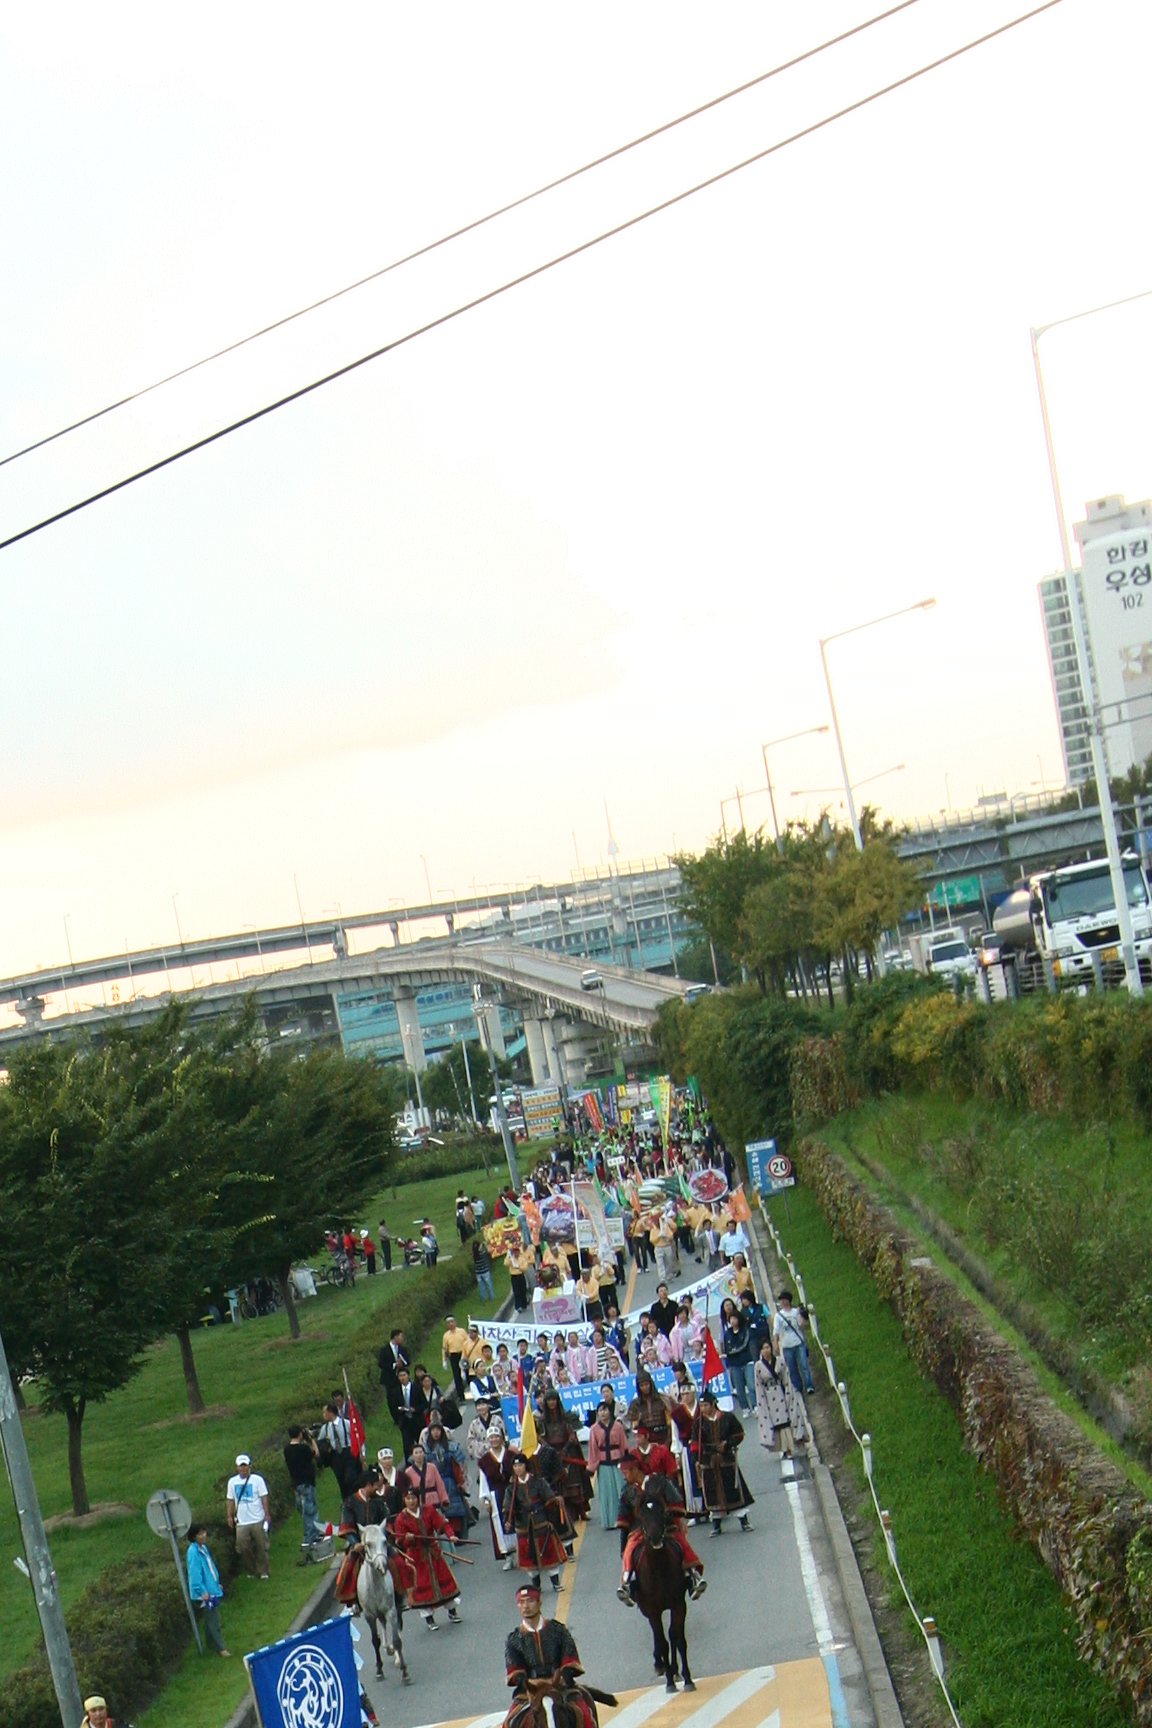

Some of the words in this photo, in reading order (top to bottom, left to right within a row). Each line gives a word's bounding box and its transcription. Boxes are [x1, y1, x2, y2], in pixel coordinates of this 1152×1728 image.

[1106, 563, 1151, 592] 우성
[1122, 592, 1144, 610] 102
[772, 1160, 788, 1174] 20
